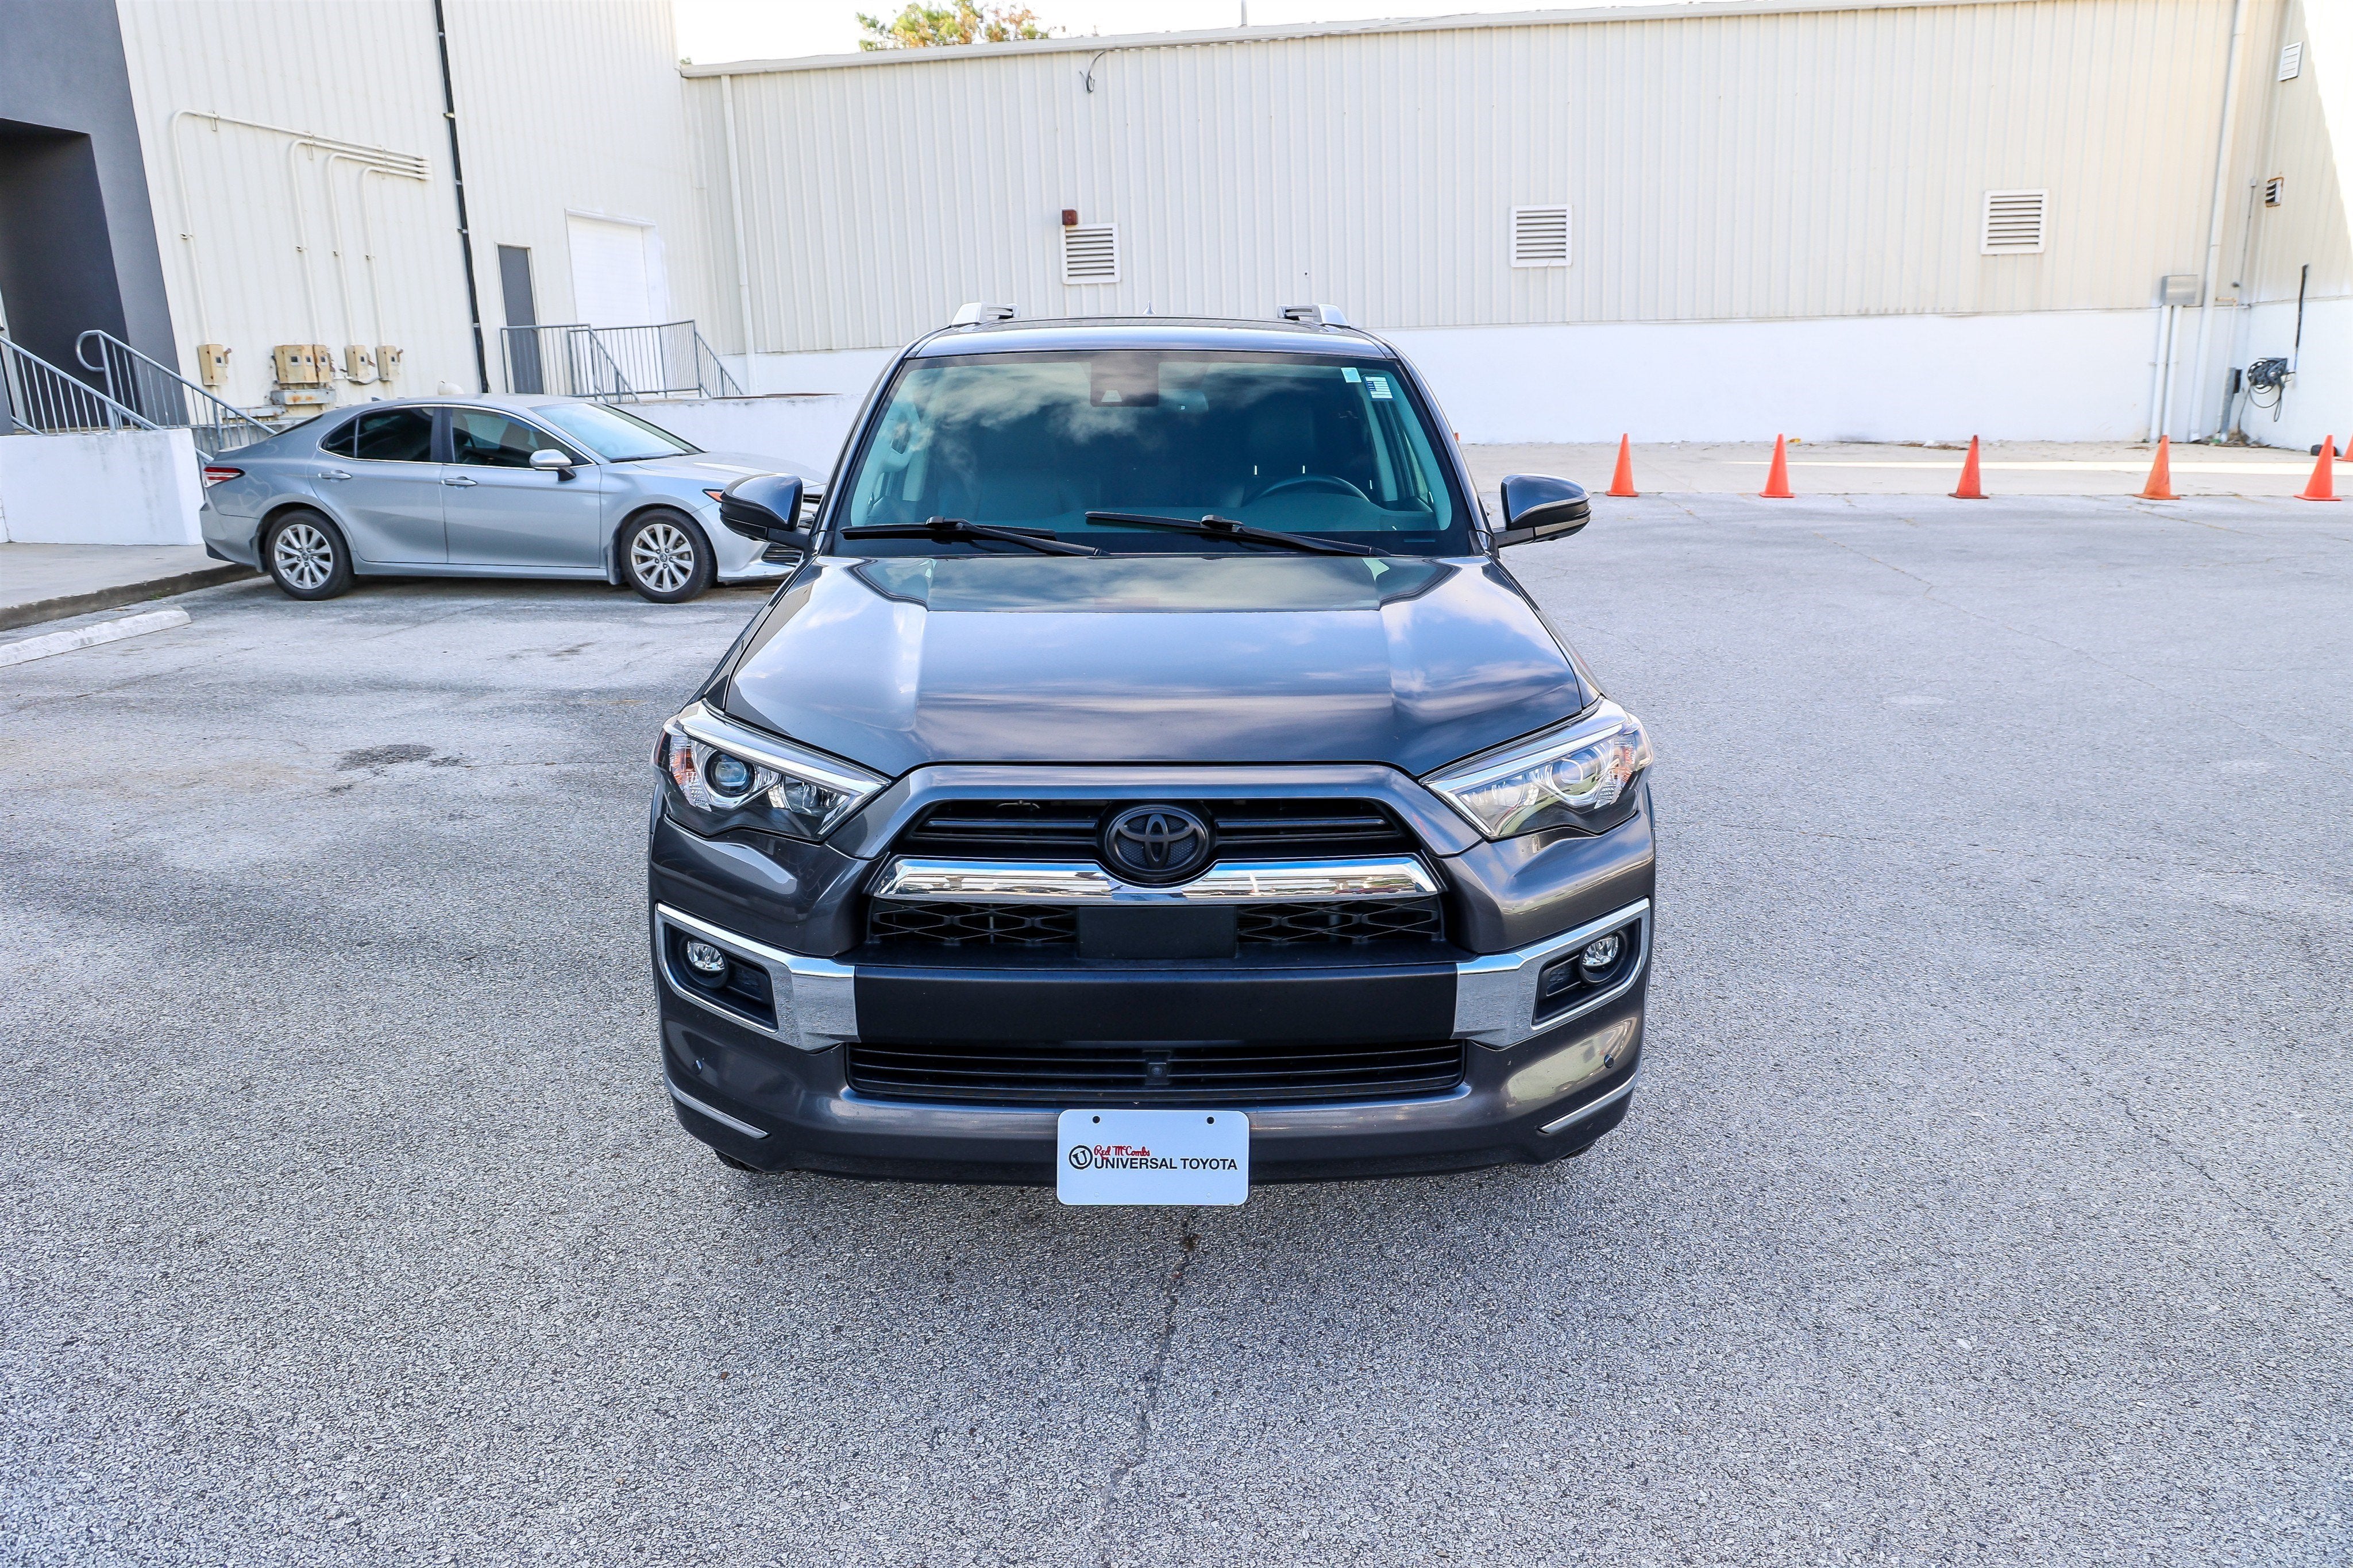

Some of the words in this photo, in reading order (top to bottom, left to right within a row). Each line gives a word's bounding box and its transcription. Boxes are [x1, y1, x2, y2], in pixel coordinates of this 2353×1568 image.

[1094, 1145, 1111, 1160] Red
[1112, 1145, 1151, 1157] McCombs
[1094, 1157, 1178, 1169] UNIVERSAL
[1180, 1158, 1238, 1170] TOYOTA
